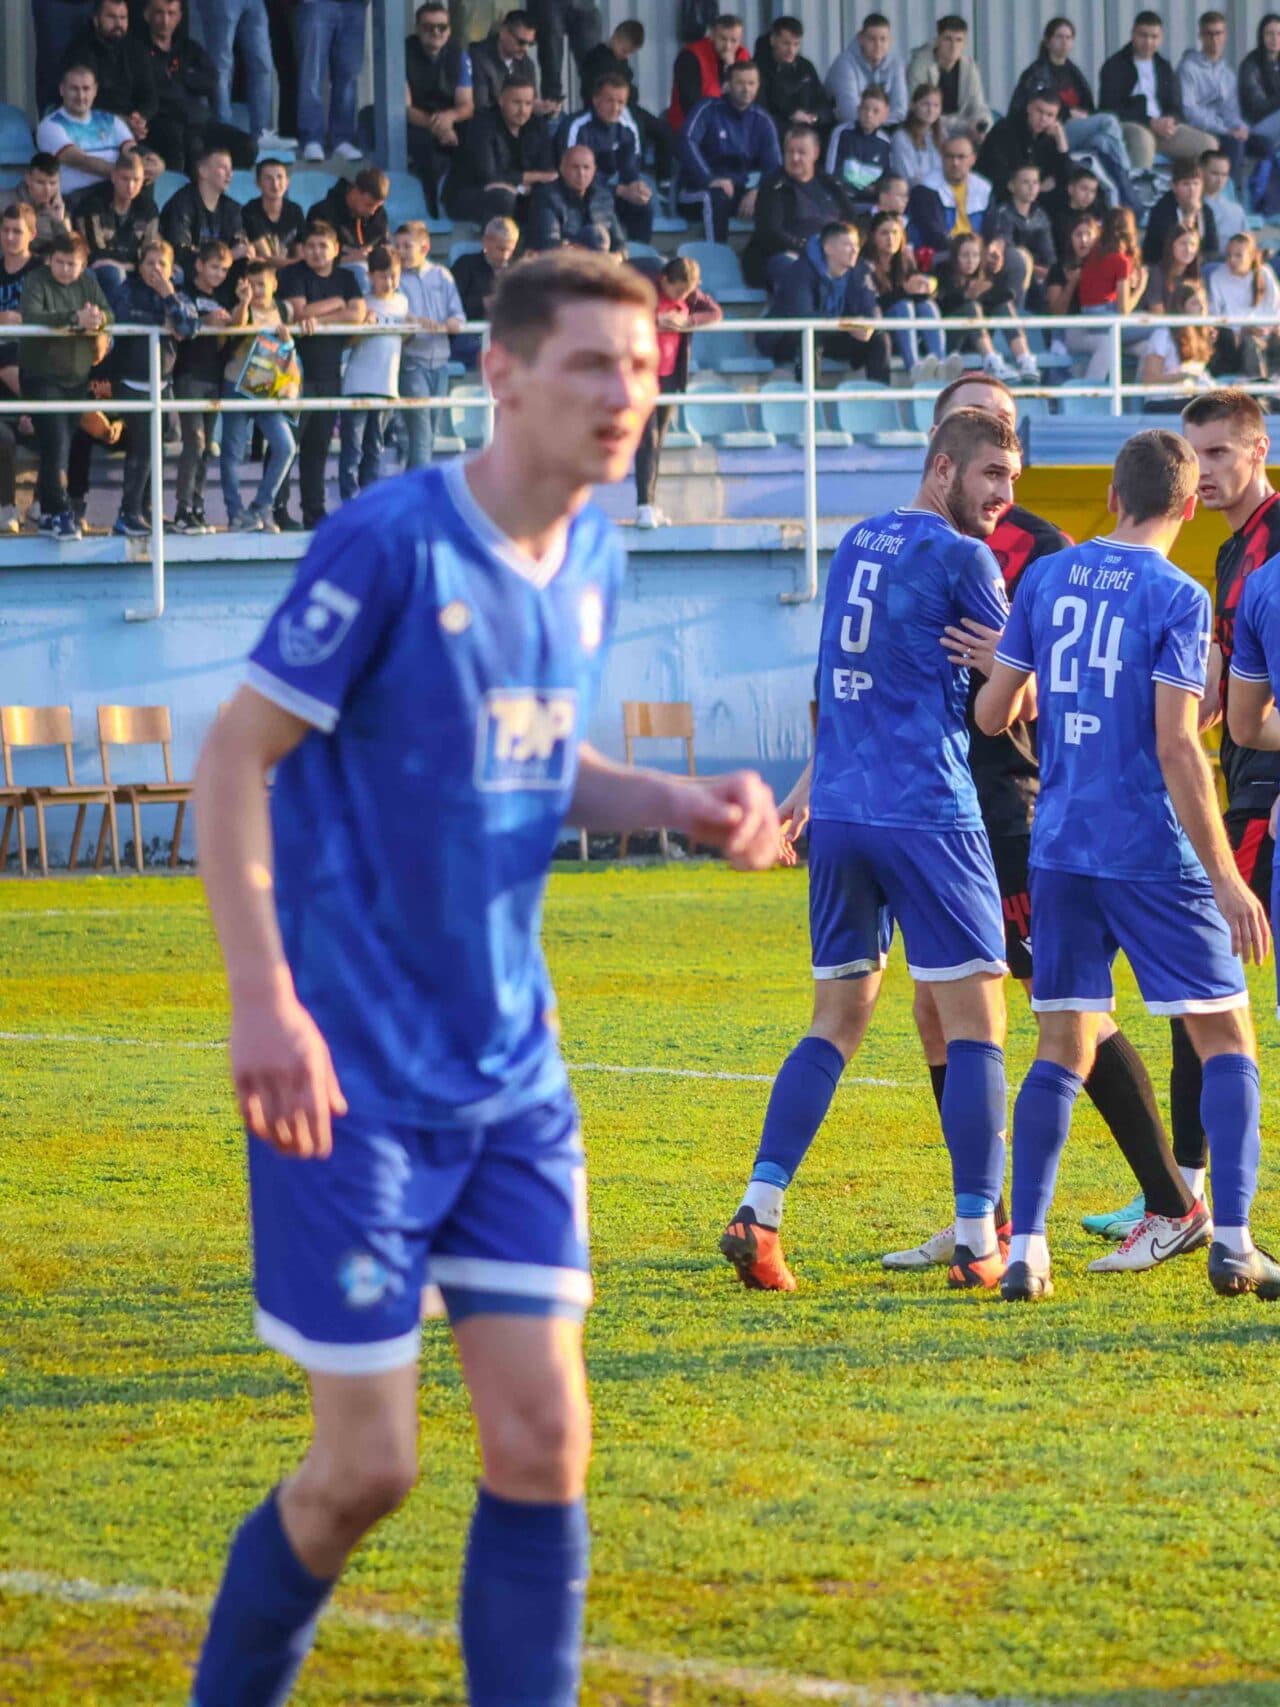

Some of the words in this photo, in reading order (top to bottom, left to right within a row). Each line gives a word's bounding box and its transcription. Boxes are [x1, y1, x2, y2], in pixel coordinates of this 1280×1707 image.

[853, 528, 875, 549] NK
[840, 560, 882, 654] 5
[1068, 564, 1092, 587] NK
[1092, 566, 1135, 592] ŽEPČE
[1050, 595, 1125, 698] 24
